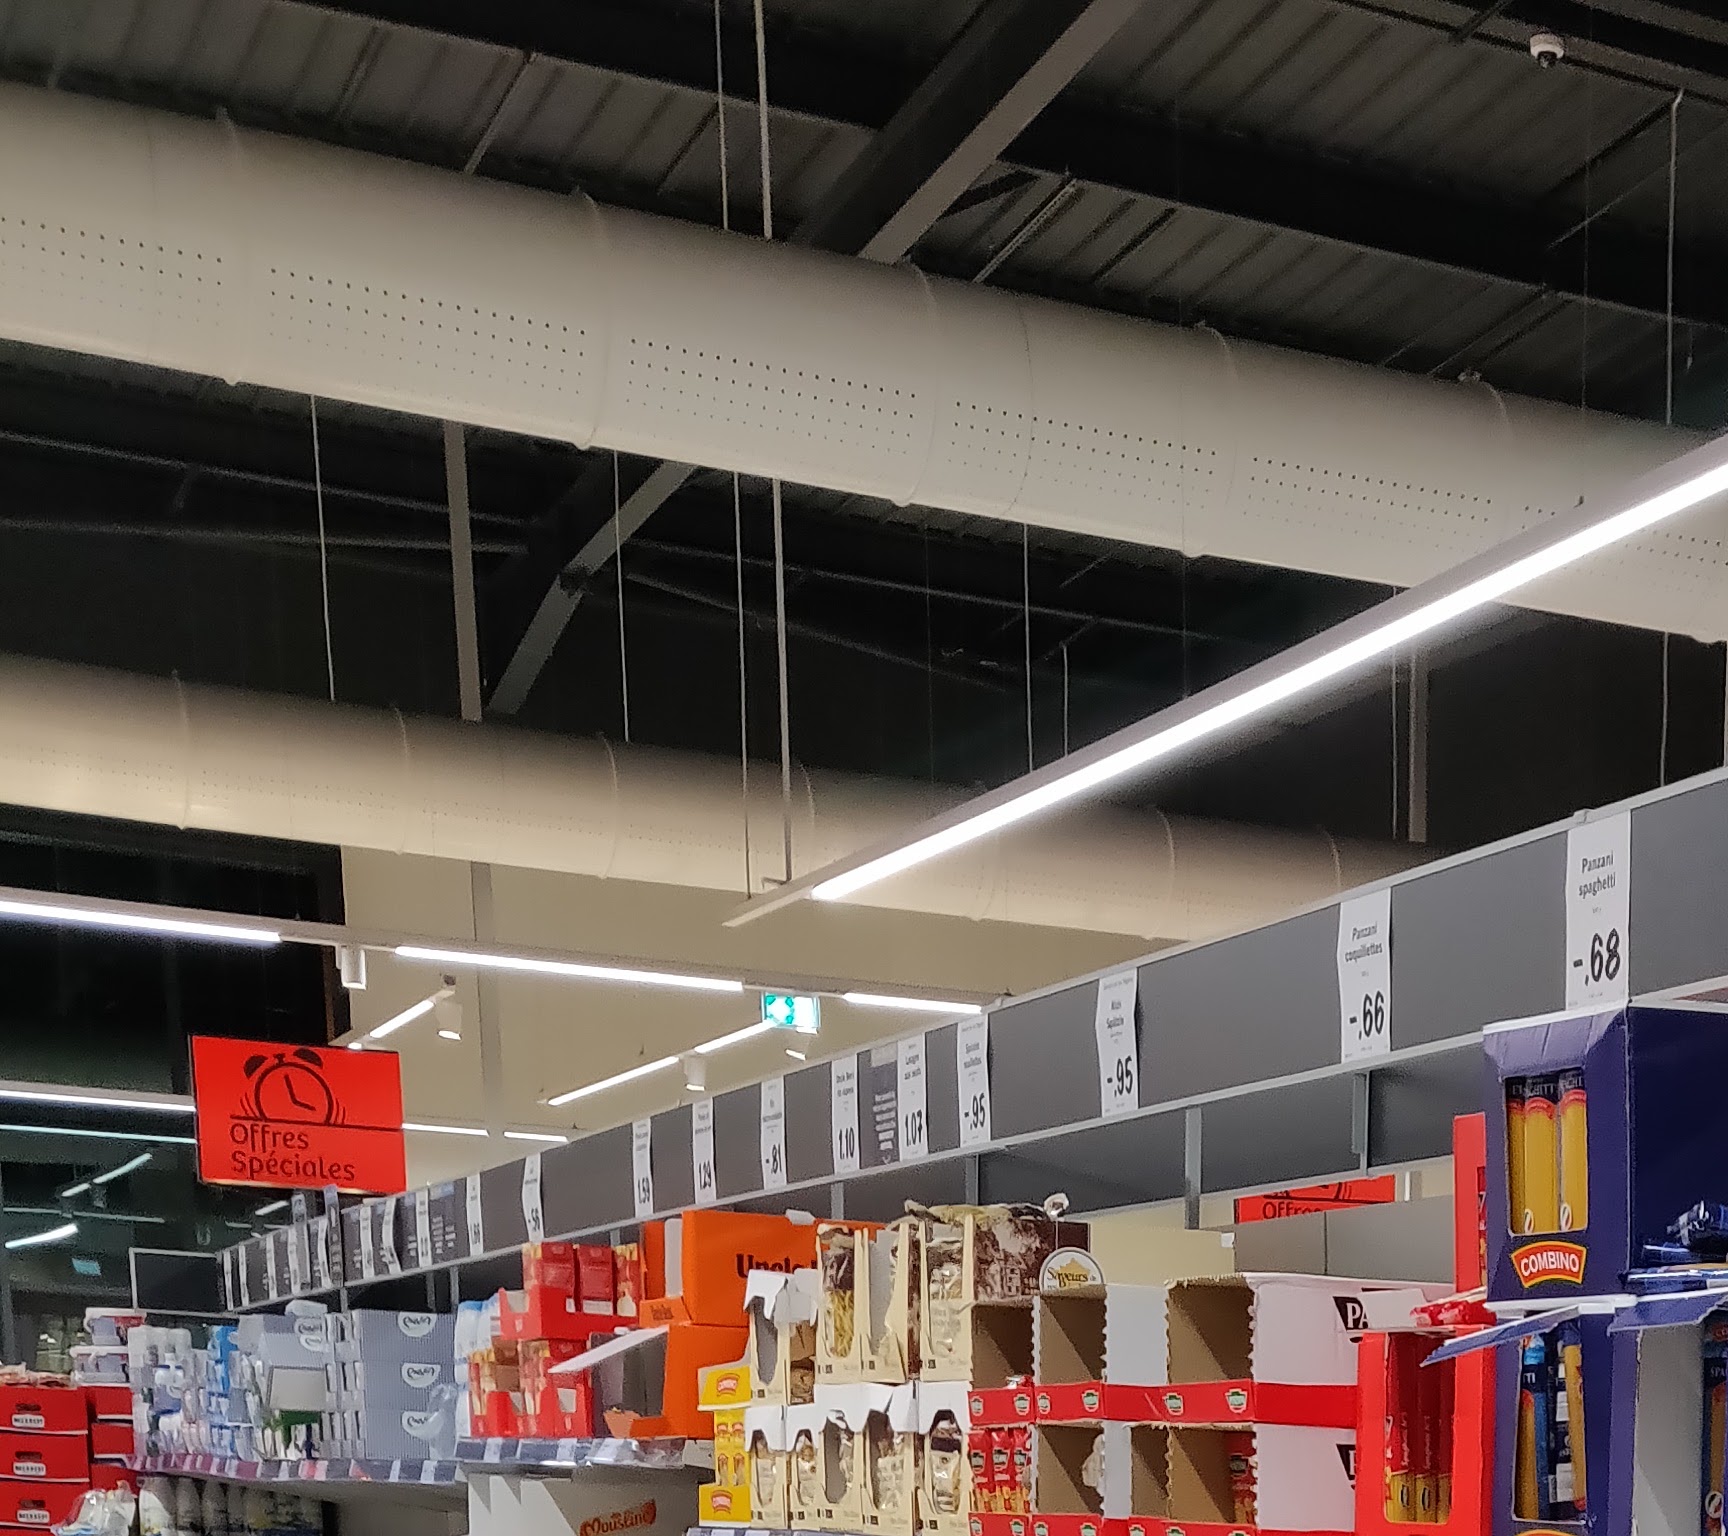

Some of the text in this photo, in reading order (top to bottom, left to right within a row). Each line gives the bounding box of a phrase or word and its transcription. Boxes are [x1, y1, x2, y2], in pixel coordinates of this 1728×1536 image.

[1582, 851, 1614, 874] Panzani
[1579, 872, 1616, 900] spaghetti
[1573, 927, 1621, 986] -.68
[1350, 990, 1385, 1041] -.66
[1107, 1055, 1133, 1098] -.95
[905, 1109, 923, 1148] 1.07
[964, 1092, 986, 1131] -.95
[230, 1123, 309, 1153] Offres
[838, 1126, 855, 1160] 1.10
[231, 1150, 355, 1182] Spéciales
[1521, 1250, 1579, 1277] COMBINO
